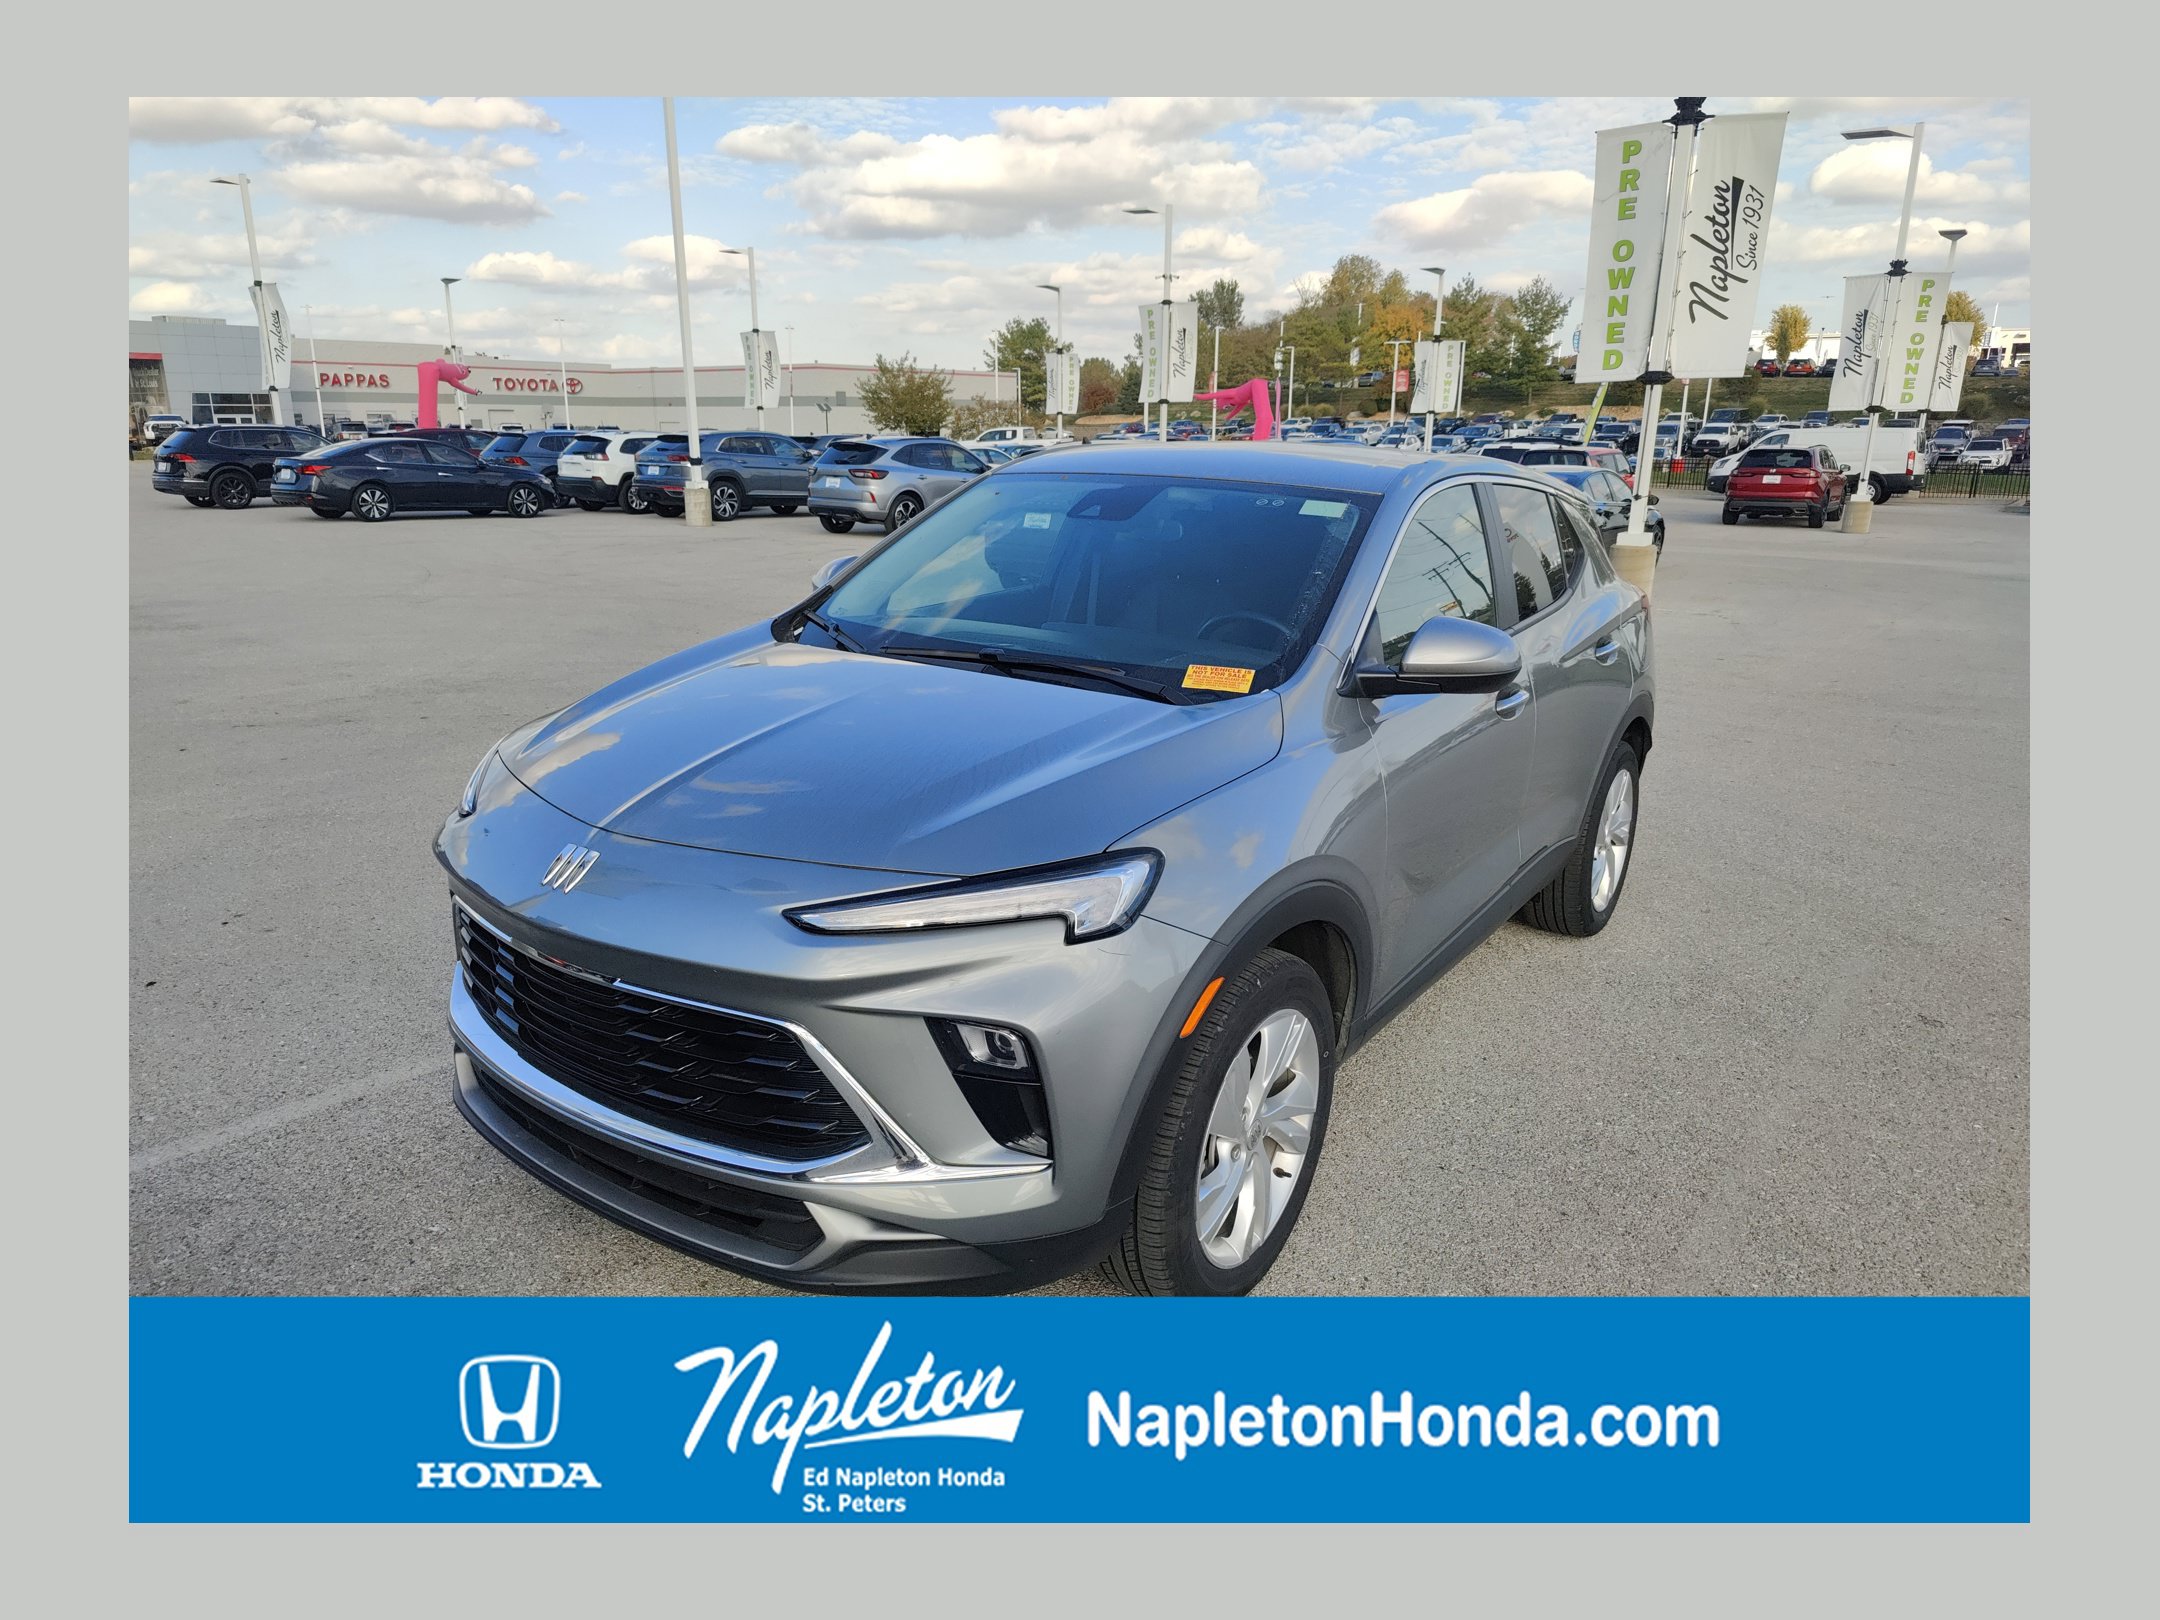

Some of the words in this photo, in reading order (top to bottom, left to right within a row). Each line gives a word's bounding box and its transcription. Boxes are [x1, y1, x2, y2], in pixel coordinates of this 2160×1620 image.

[1617, 140, 1643, 221] PRE
[1742, 184, 1765, 230] 1931
[1688, 175, 1749, 325] Napleton
[1735, 231, 1759, 271] Since
[1147, 309, 1156, 340] PRE
[1601, 239, 1636, 371] OWNED
[1915, 279, 1936, 323] PRE
[269, 309, 288, 363] Napleton
[1171, 327, 1191, 378] Napleton
[1842, 309, 1872, 379] Napleton
[319, 372, 391, 388] PAPPAS
[492, 377, 560, 392] TOYOTA
[1147, 347, 1157, 398] OWNED
[1900, 332, 1925, 404] OWNED
[1938, 345, 1958, 390] Napleton
